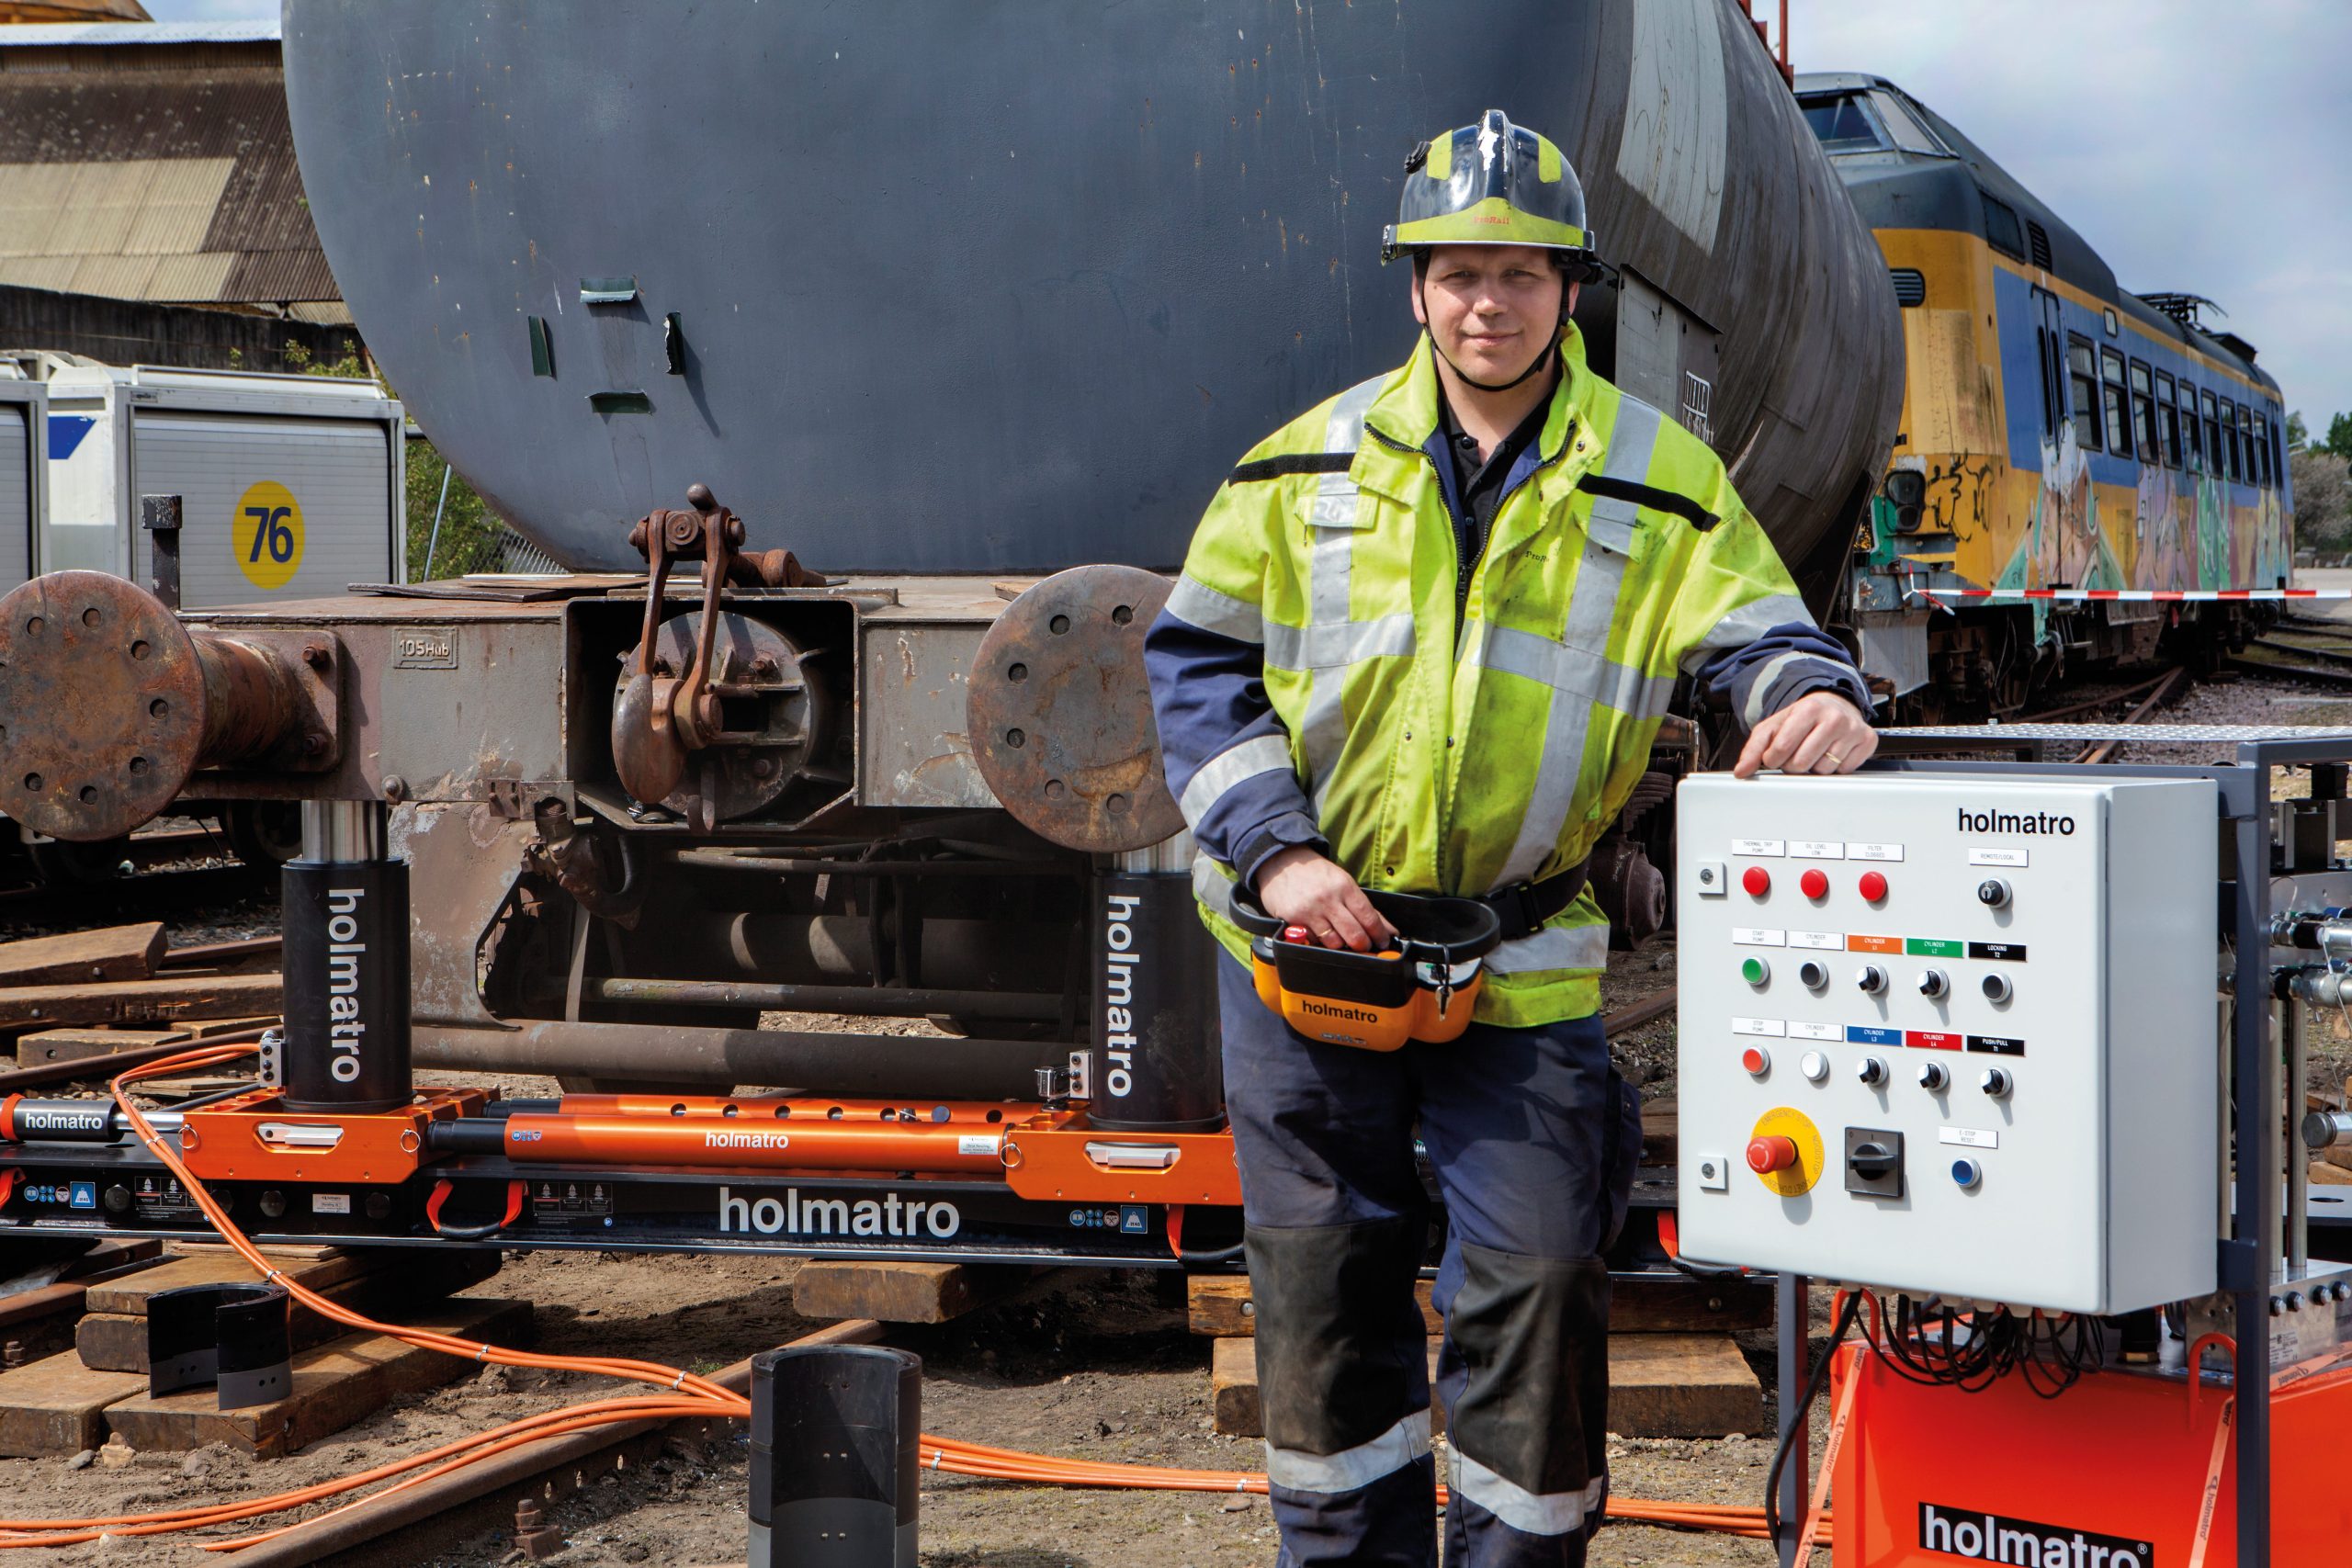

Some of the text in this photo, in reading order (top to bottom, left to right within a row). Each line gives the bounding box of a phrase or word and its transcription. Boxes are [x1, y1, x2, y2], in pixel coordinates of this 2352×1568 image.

[244, 507, 294, 563] 76
[399, 639, 450, 658] 105Hub
[1958, 807, 2075, 836] holmatro
[1980, 852, 2015, 861] REMOTE/LOCAL
[1987, 944, 2007, 953] LOCKING
[328, 888, 366, 1082] holmatro
[1107, 895, 1140, 1097] holmatro
[1301, 1000, 1378, 1023] holmatro
[1982, 1038, 2009, 1046] PUSH/PULL
[25, 1112, 103, 1131] holmatro
[1761, 1109, 1812, 1128] EMERGENCY STOP
[705, 1131, 789, 1149] holmatro
[718, 1186, 960, 1238] holmatro
